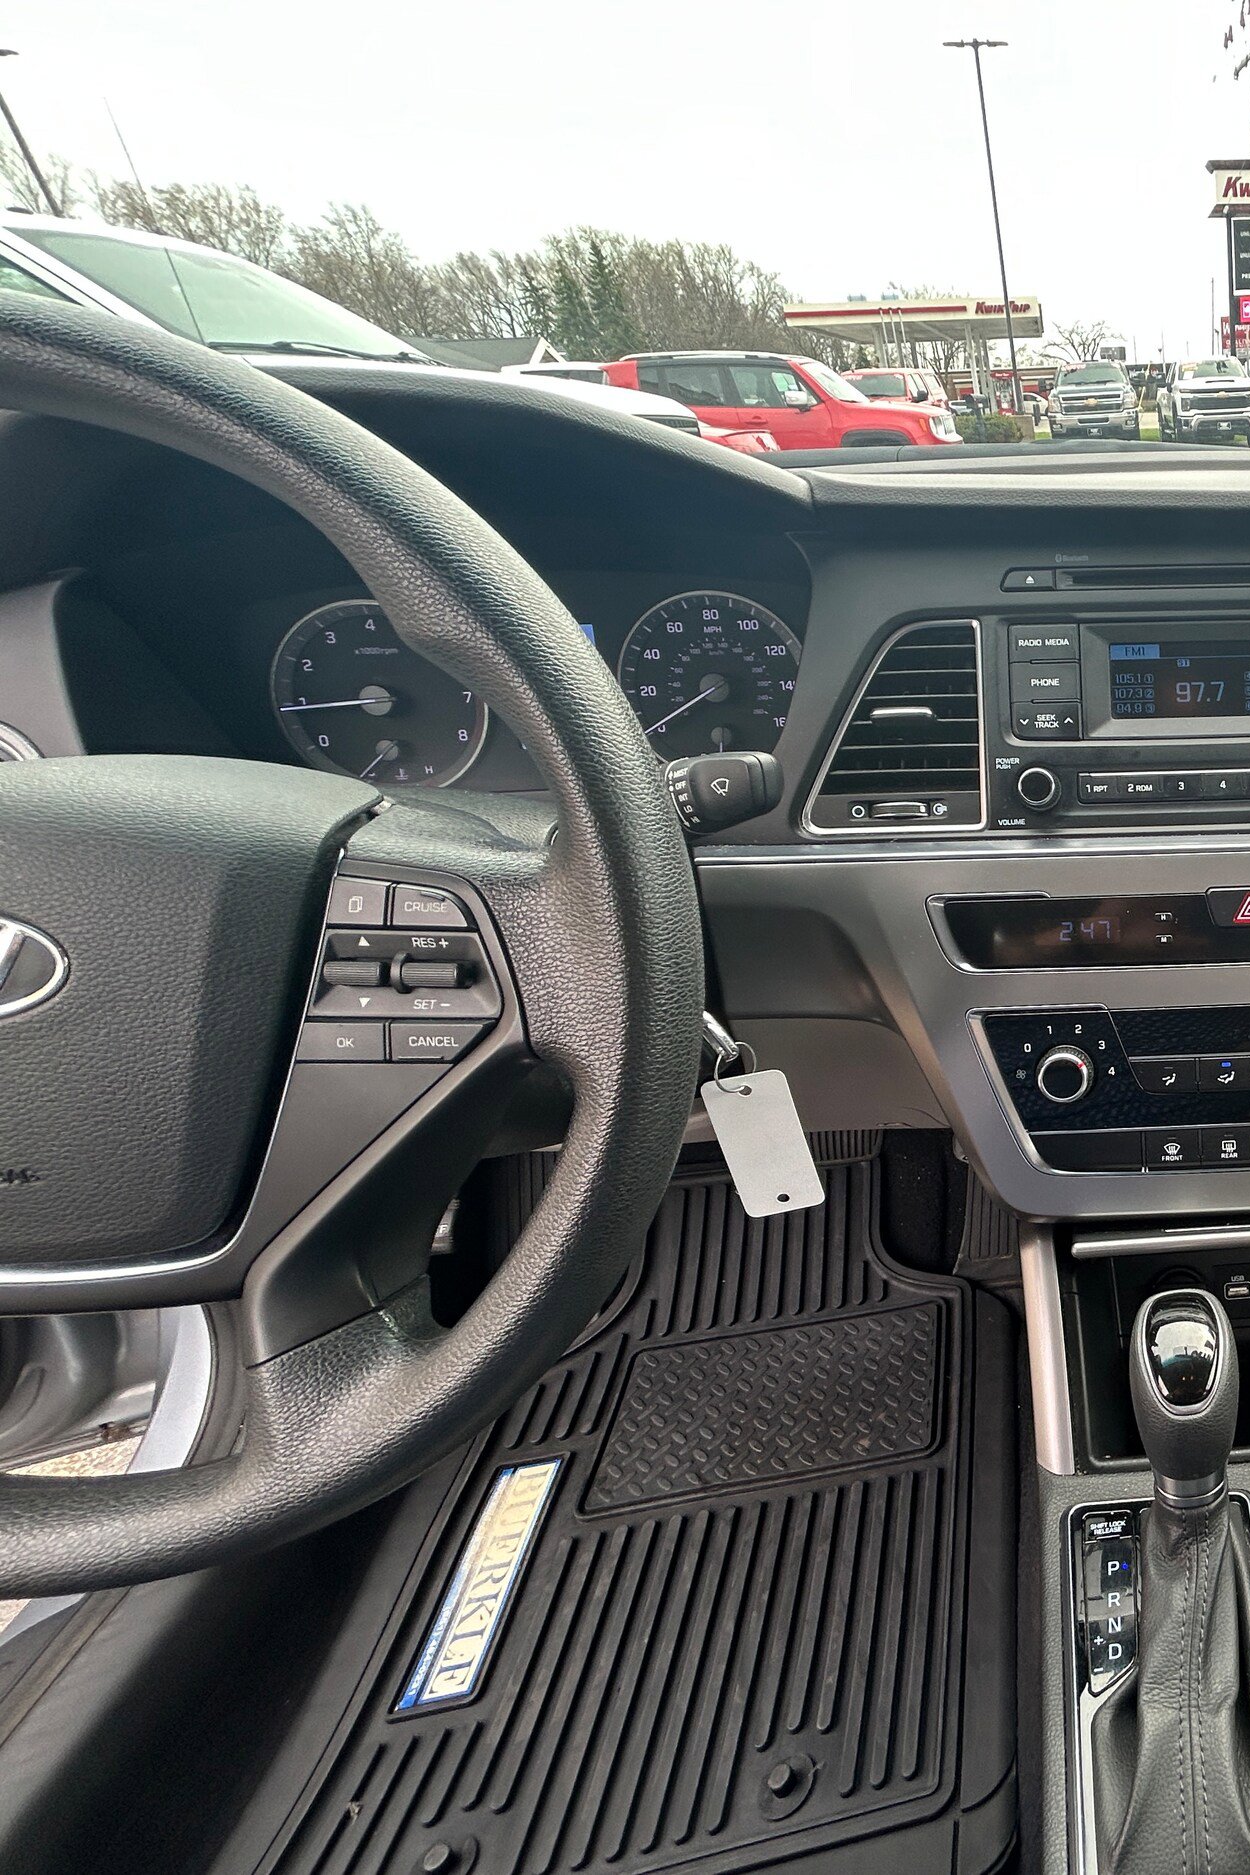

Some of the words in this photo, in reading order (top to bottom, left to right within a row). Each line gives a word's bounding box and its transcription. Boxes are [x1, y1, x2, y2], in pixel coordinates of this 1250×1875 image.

[702, 609, 719, 620] 80
[364, 619, 376, 631] 4
[666, 622, 683, 633] 60
[736, 620, 758, 631] 100
[325, 632, 336, 644] 3
[643, 649, 661, 660] 40
[764, 645, 786, 656] 120
[302, 660, 313, 671] 2
[640, 685, 657, 697] 20
[780, 680, 796, 691] 14
[462, 691, 472, 704] 7
[1176, 681, 1225, 703] 97.7
[1034, 721, 1059, 729] TRACK
[319, 735, 329, 747] 0
[458, 730, 469, 742] 8
[675, 781, 687, 790] OFF
[1085, 784, 1091, 793] 1
[1093, 785, 1108, 793] RPT
[1127, 783, 1134, 792] 2
[1136, 784, 1152, 792] RDM
[1178, 782, 1185, 791] 3
[1220, 780, 1226, 788] 4
[678, 793, 688, 802] INT
[998, 818, 1025, 826] VOLUME
[404, 901, 448, 912] CRUISE
[411, 937, 437, 948] RES
[413, 999, 437, 1010] SET
[1046, 1025, 1053, 1035] 1
[1074, 1024, 1082, 1034] 2
[336, 1037, 354, 1048] OK
[408, 1036, 459, 1047] CANCEL
[1098, 1040, 1106, 1050] 3
[1023, 1043, 1032, 1053] 0
[1108, 1066, 1115, 1076] 4
[1090, 1521, 1109, 1530] SHIFT
[1109, 1520, 1126, 1528] LOCK
[1093, 1526, 1123, 1535] RELEASE
[1107, 1560, 1119, 1576] P
[428, 1468, 552, 1695] BUERKLE
[1108, 1592, 1120, 1608] R
[1108, 1616, 1121, 1633] N
[1108, 1643, 1122, 1660] D
